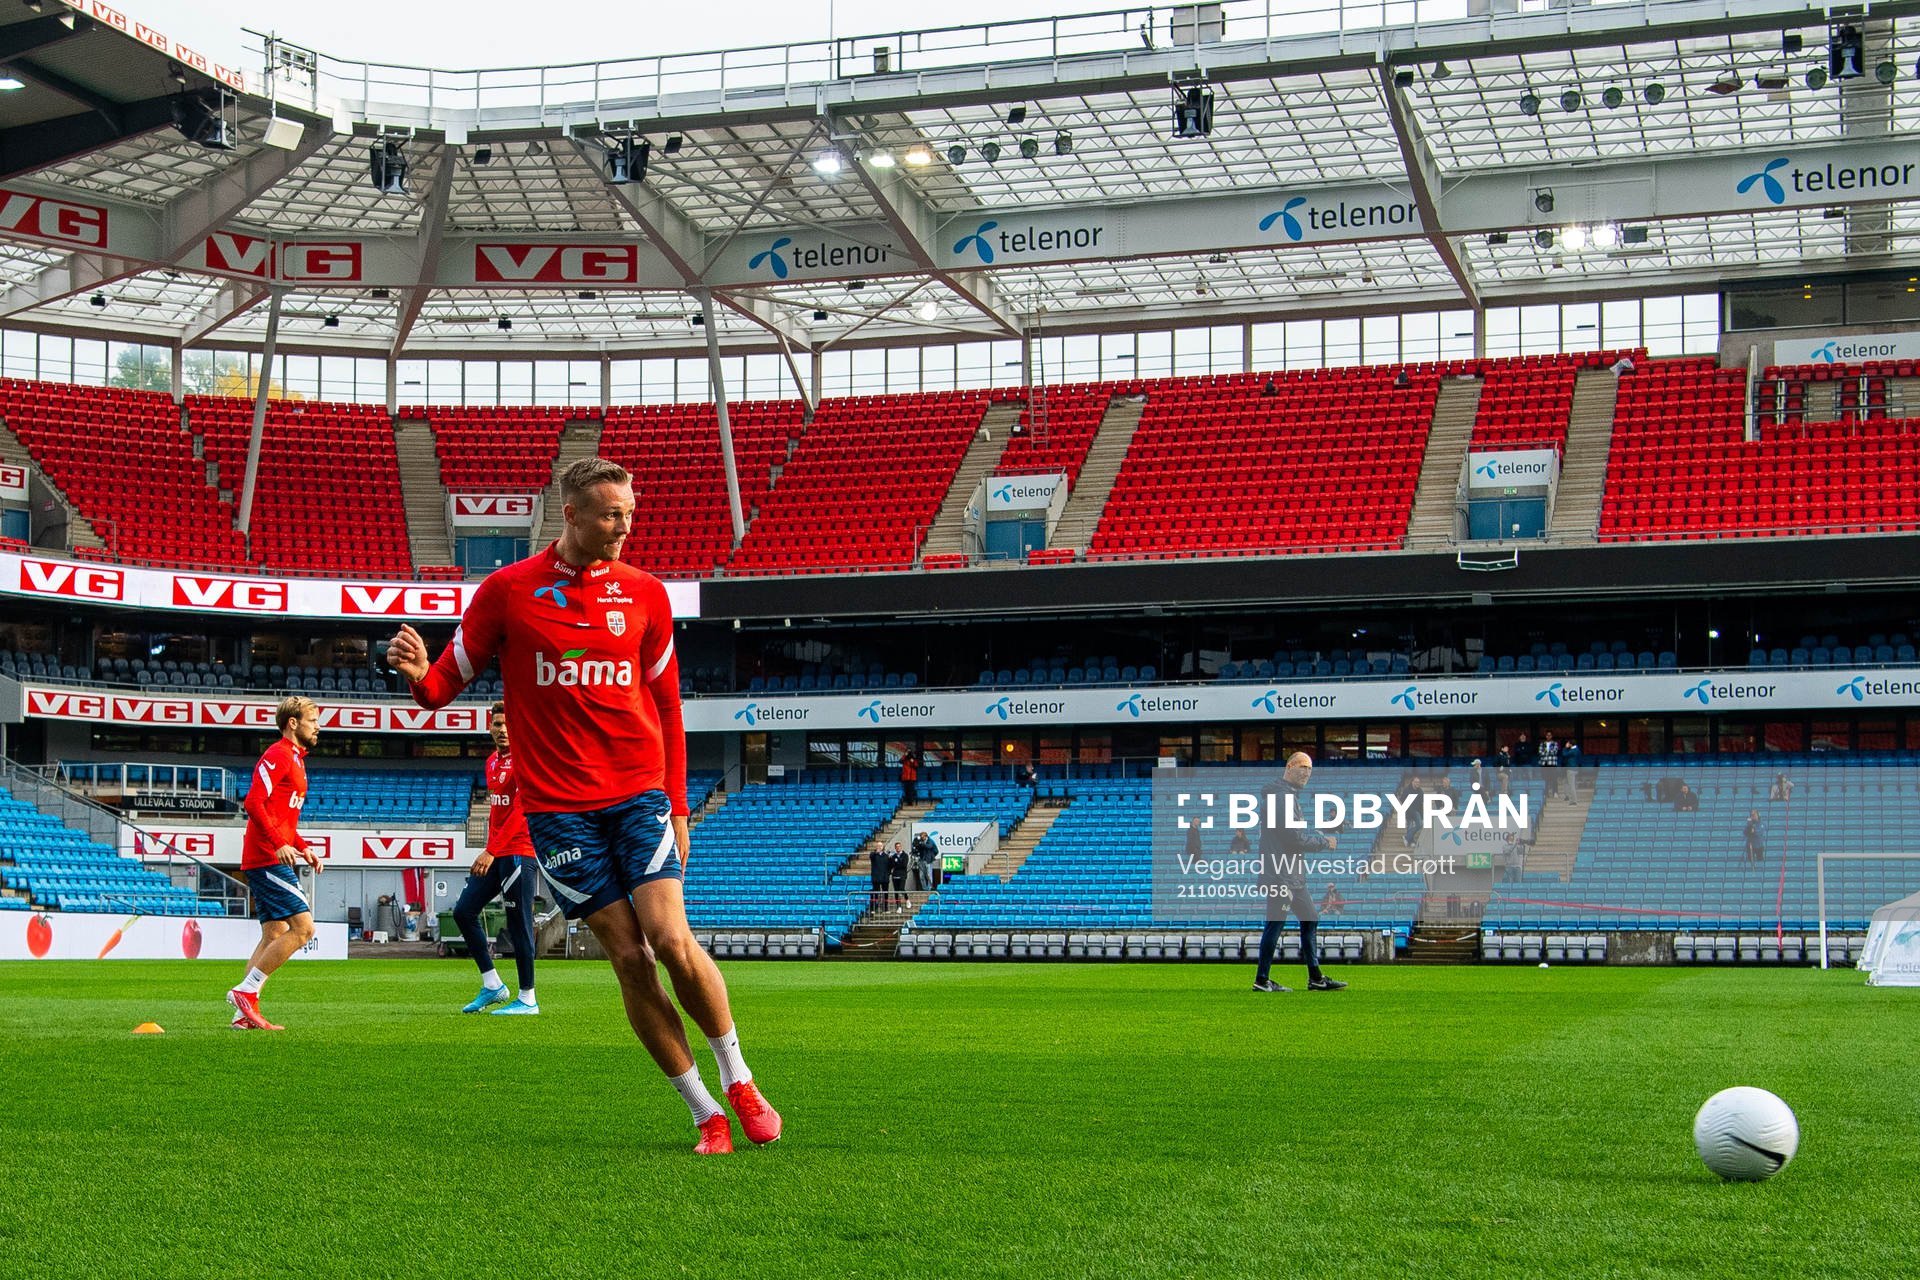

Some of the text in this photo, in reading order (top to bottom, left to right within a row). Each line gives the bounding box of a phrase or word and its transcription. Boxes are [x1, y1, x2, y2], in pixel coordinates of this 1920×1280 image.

[97, 4, 126, 30] VG
[138, 24, 167, 50] VG
[178, 46, 206, 71] VG
[217, 66, 244, 90] VG
[1792, 163, 1915, 192] telenor
[1308, 202, 1417, 230] telenor
[1000, 226, 1103, 254] telenor
[212, 232, 353, 279] VG
[481, 246, 630, 282] VG
[793, 243, 891, 269] telenor
[1836, 342, 1897, 359] telenor
[1498, 462, 1547, 475] telenor
[459, 497, 528, 514] VG
[23, 562, 120, 599] VG
[175, 577, 286, 611] VG
[343, 586, 459, 615] VG
[535, 651, 633, 687] bama
[1276, 693, 1336, 710] telenor
[1417, 690, 1478, 706] telenor
[1561, 686, 1624, 702] telenor
[1710, 683, 1776, 699] telenor
[31, 692, 104, 717] VG
[114, 699, 191, 723] VG
[204, 703, 277, 725] VG
[756, 706, 809, 720] telenor
[881, 703, 935, 718] telenor
[1008, 700, 1065, 715] telenor
[1141, 696, 1199, 713] telenor
[392, 709, 472, 730] VG
[134, 797, 215, 810] ULLEVAAL STADION
[136, 833, 210, 856] VG
[364, 838, 450, 860] VG
[544, 847, 582, 870] bama
